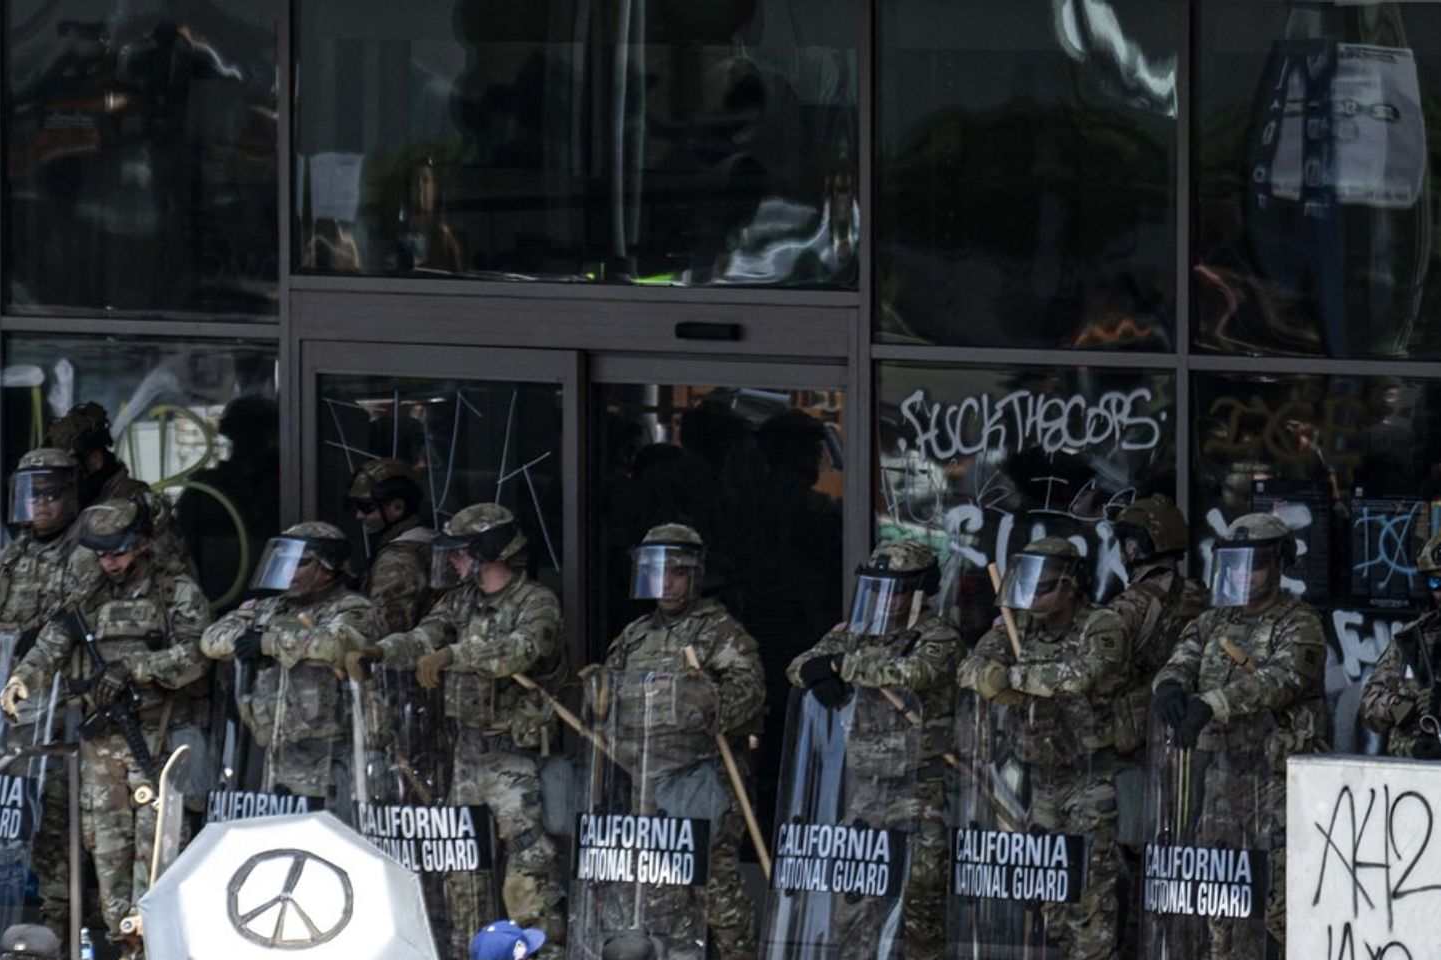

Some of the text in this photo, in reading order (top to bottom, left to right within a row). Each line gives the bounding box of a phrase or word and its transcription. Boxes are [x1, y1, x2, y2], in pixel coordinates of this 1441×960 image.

[358, 802, 476, 838] CALIFORNIA
[578, 813, 696, 851] CALIFORNIA
[422, 838, 480, 872] GUARD
[777, 822, 890, 863] CALIFORNIA
[955, 828, 1069, 868] CALIFORNIA
[577, 846, 694, 887] NATIONAL GUARD
[774, 857, 890, 897] NATIONAL GUARD
[954, 863, 1069, 902] NATIONAL GUARD
[1145, 843, 1252, 884] CALIFORNIA
[1143, 877, 1252, 919] NATIONAL GUARD
